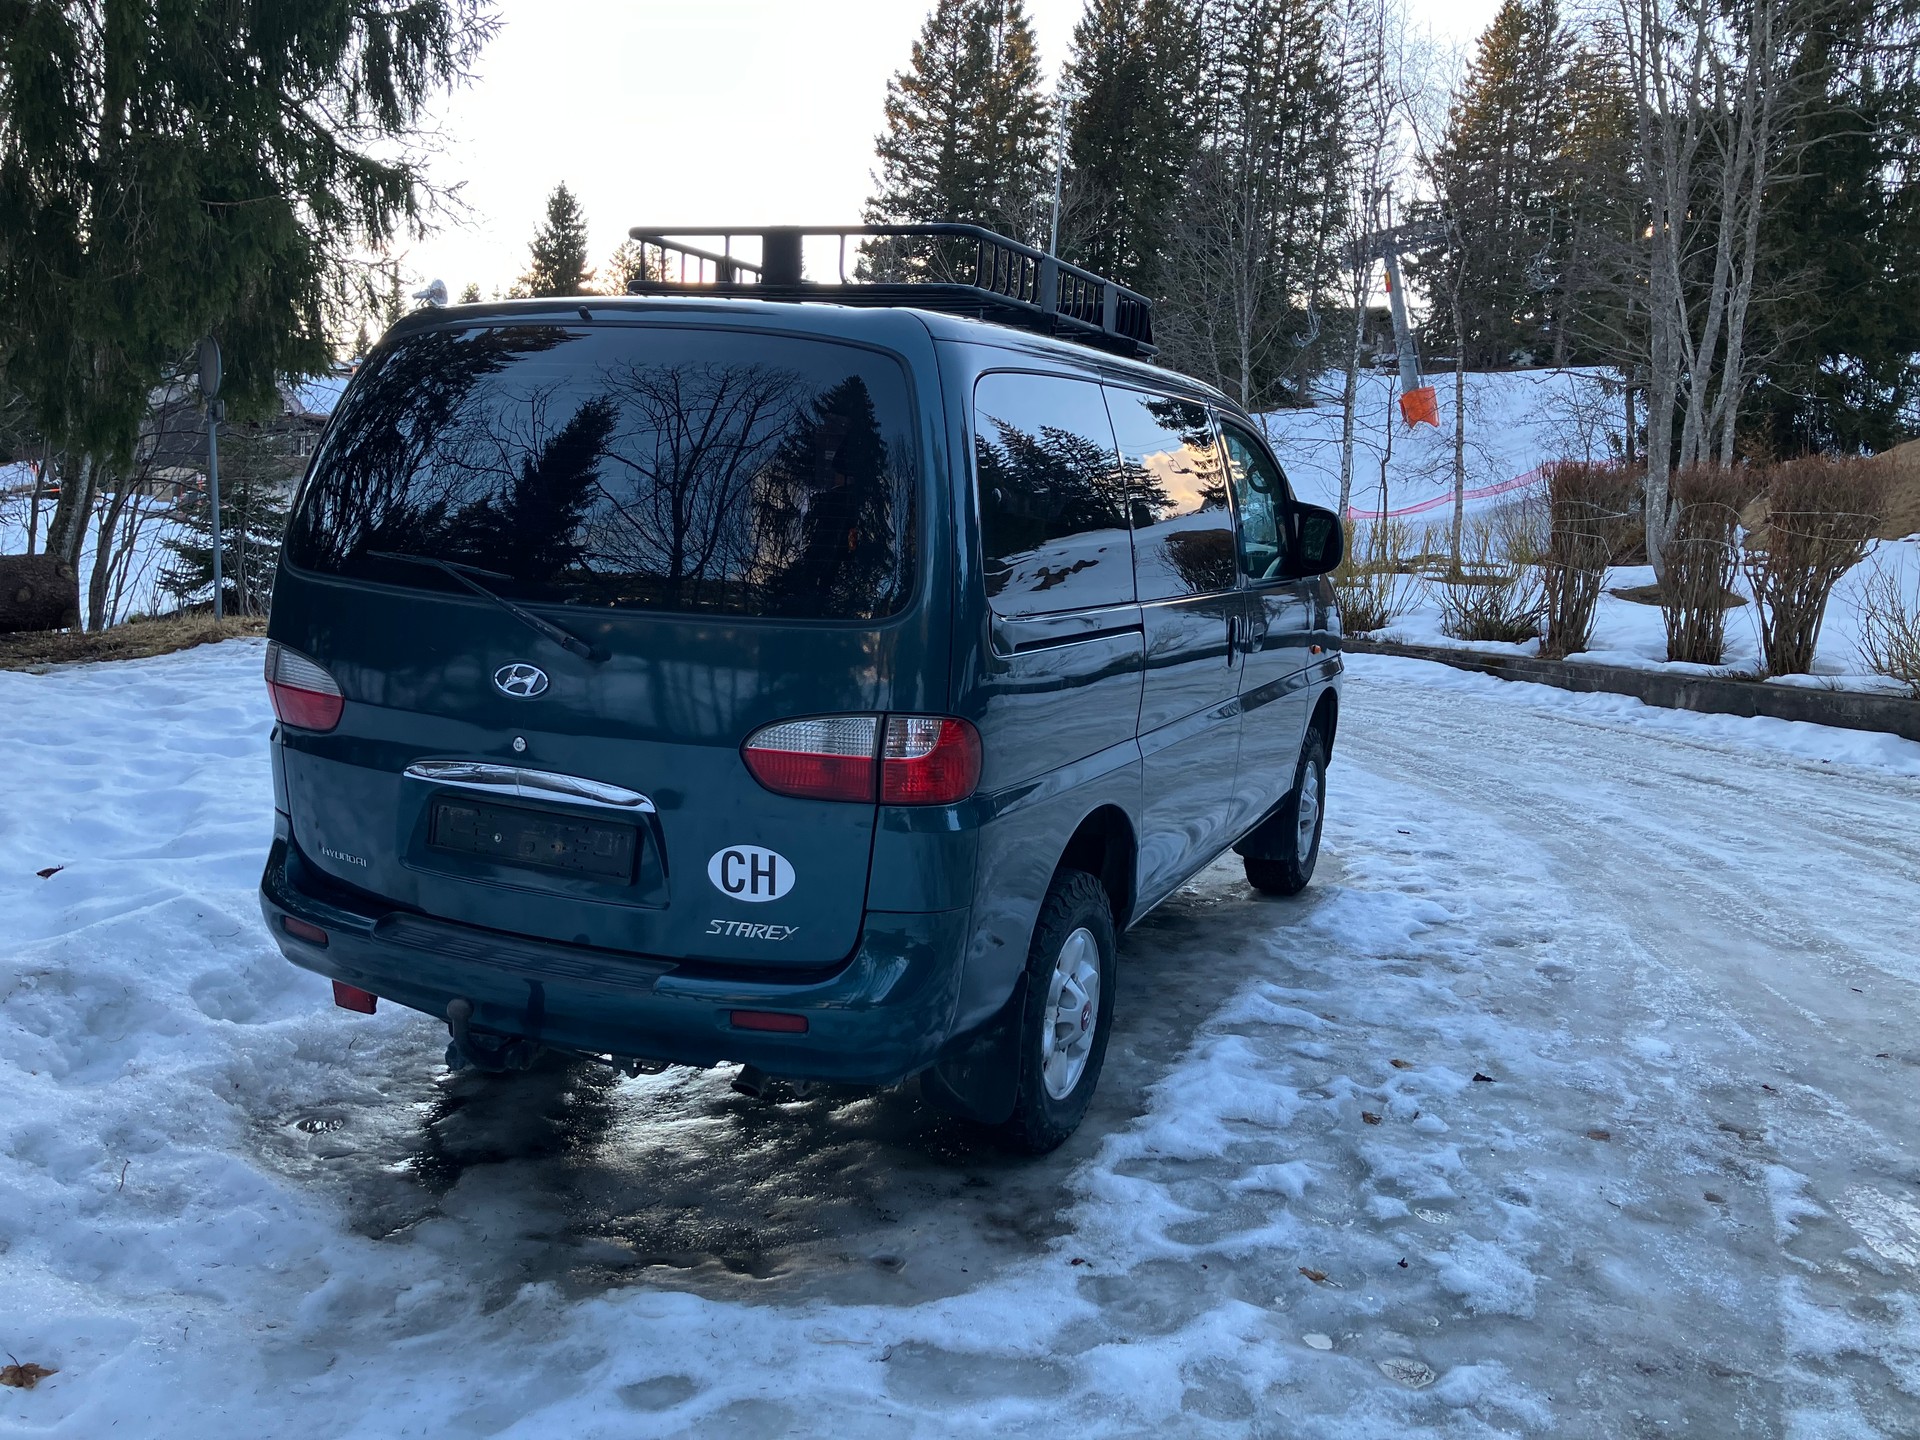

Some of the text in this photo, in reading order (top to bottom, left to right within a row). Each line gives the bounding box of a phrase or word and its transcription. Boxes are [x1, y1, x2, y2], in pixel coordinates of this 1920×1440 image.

[322, 846, 367, 867] HYUNDAI
[721, 850, 776, 896] CH
[705, 919, 800, 941] STAREX
